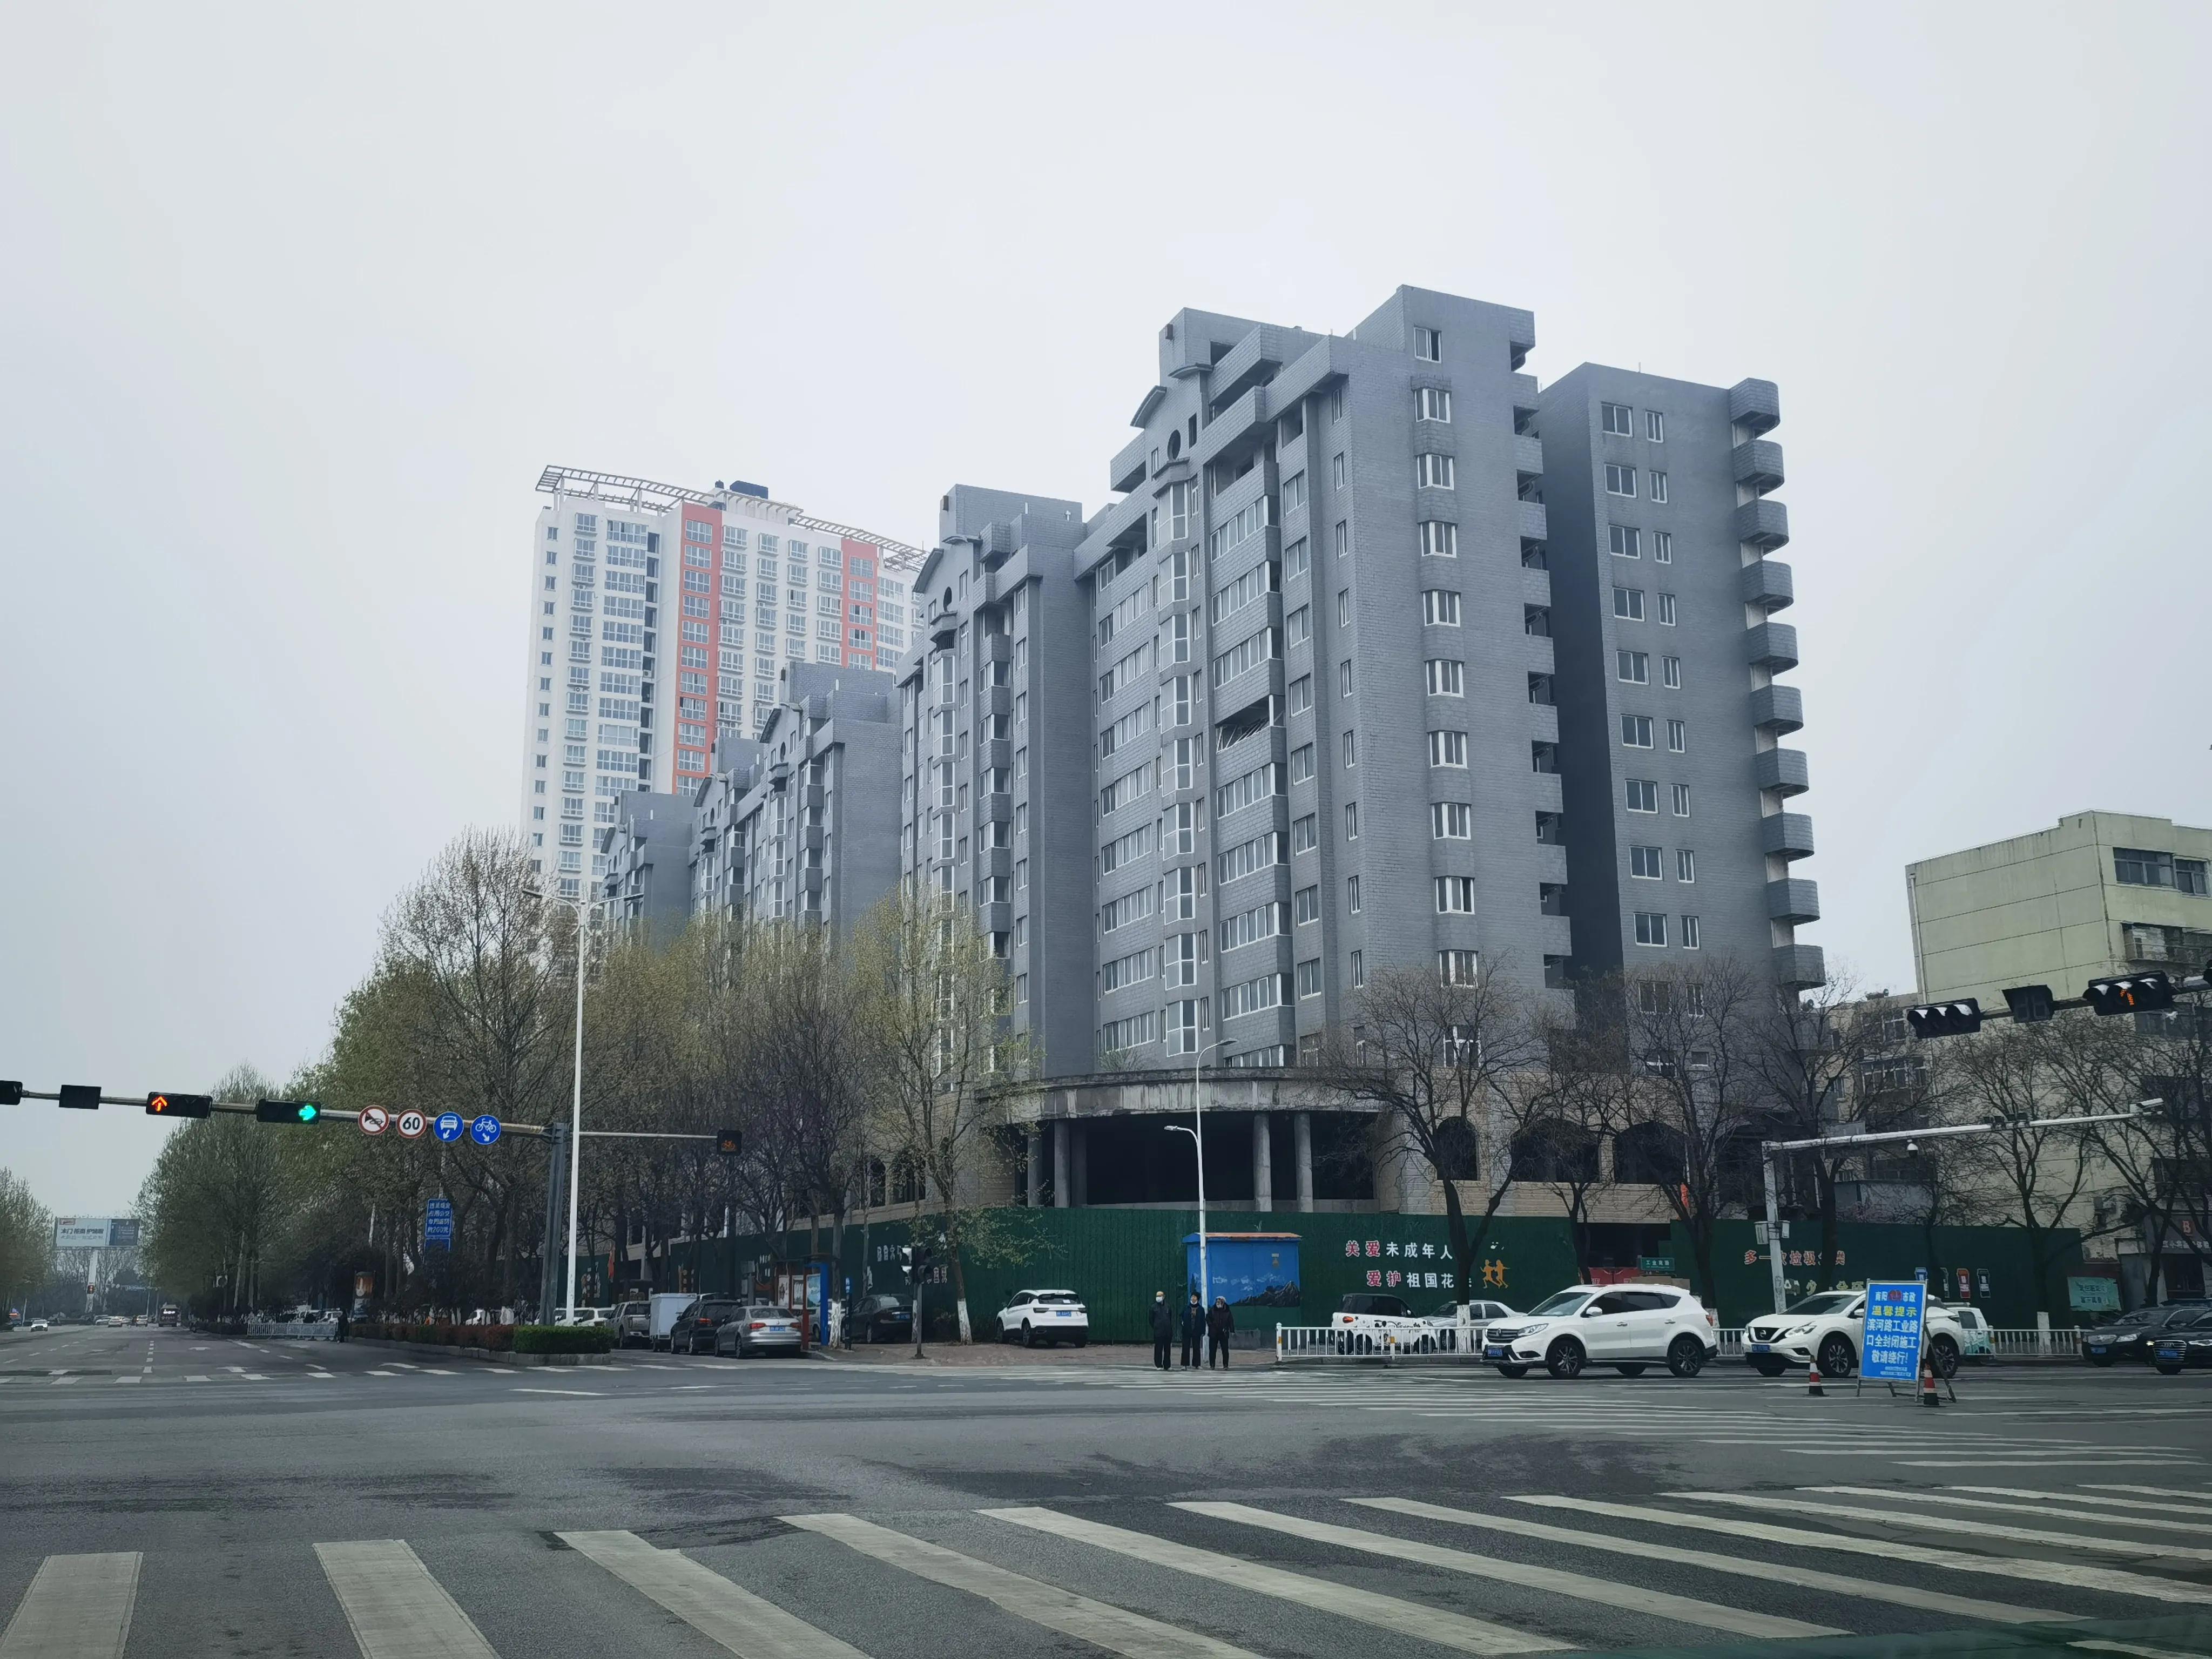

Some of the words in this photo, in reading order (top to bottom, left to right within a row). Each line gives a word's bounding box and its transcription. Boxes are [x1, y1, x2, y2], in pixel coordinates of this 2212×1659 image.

[402, 1117, 420, 1130] 60
[1346, 1240, 1453, 1260] 关爱未成年人
[1744, 1250, 1845, 1266] 多一垃圾类
[1367, 1270, 1472, 1289] 爱护祖国花
[1872, 1305, 1917, 1317] 温馨提示
[1867, 1318, 1918, 1333] 滨河路工业路
[1866, 1334, 1917, 1348] 口全封闭施工
